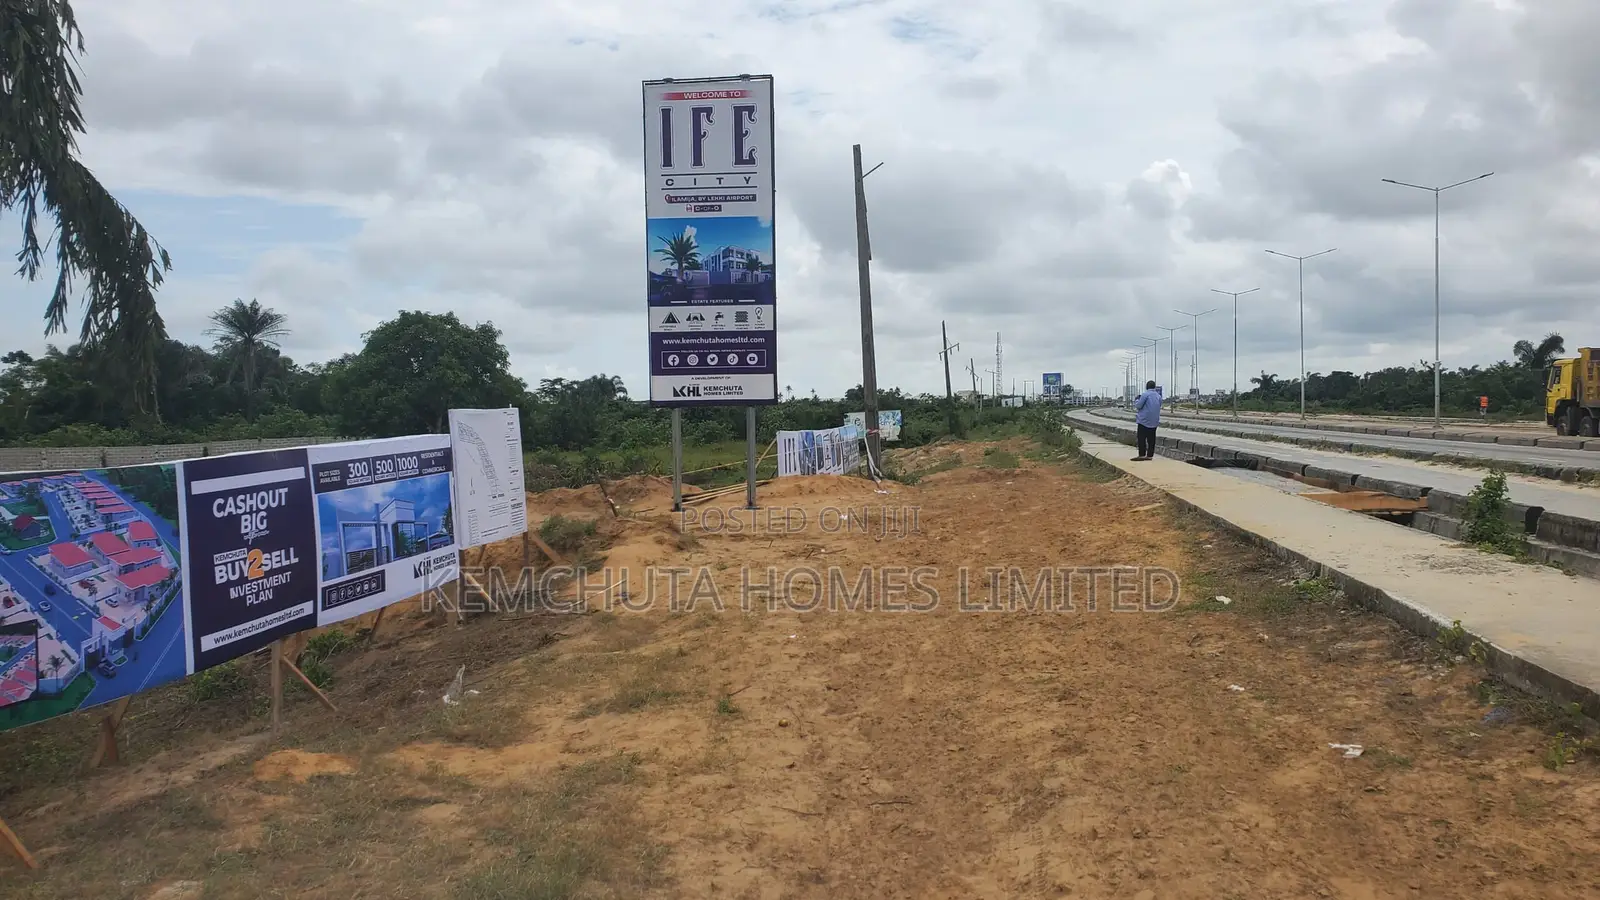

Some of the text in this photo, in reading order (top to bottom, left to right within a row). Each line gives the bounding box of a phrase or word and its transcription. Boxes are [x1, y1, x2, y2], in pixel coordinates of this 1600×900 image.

[684, 91, 727, 99] WELCOME
[659, 103, 757, 169] IFE
[665, 176, 751, 187] CITY
[662, 336, 765, 345] www.kemchutahomesltd.com
[347, 456, 419, 478] 300 500 1000
[212, 487, 288, 518] CASHOUT
[241, 511, 267, 534] BIG
[214, 550, 247, 563] KEMCHUTA
[229, 571, 292, 599] INVESTMENT
[246, 588, 273, 607] PLAN
[213, 607, 305, 645] www.kemchutahomesltd.com
